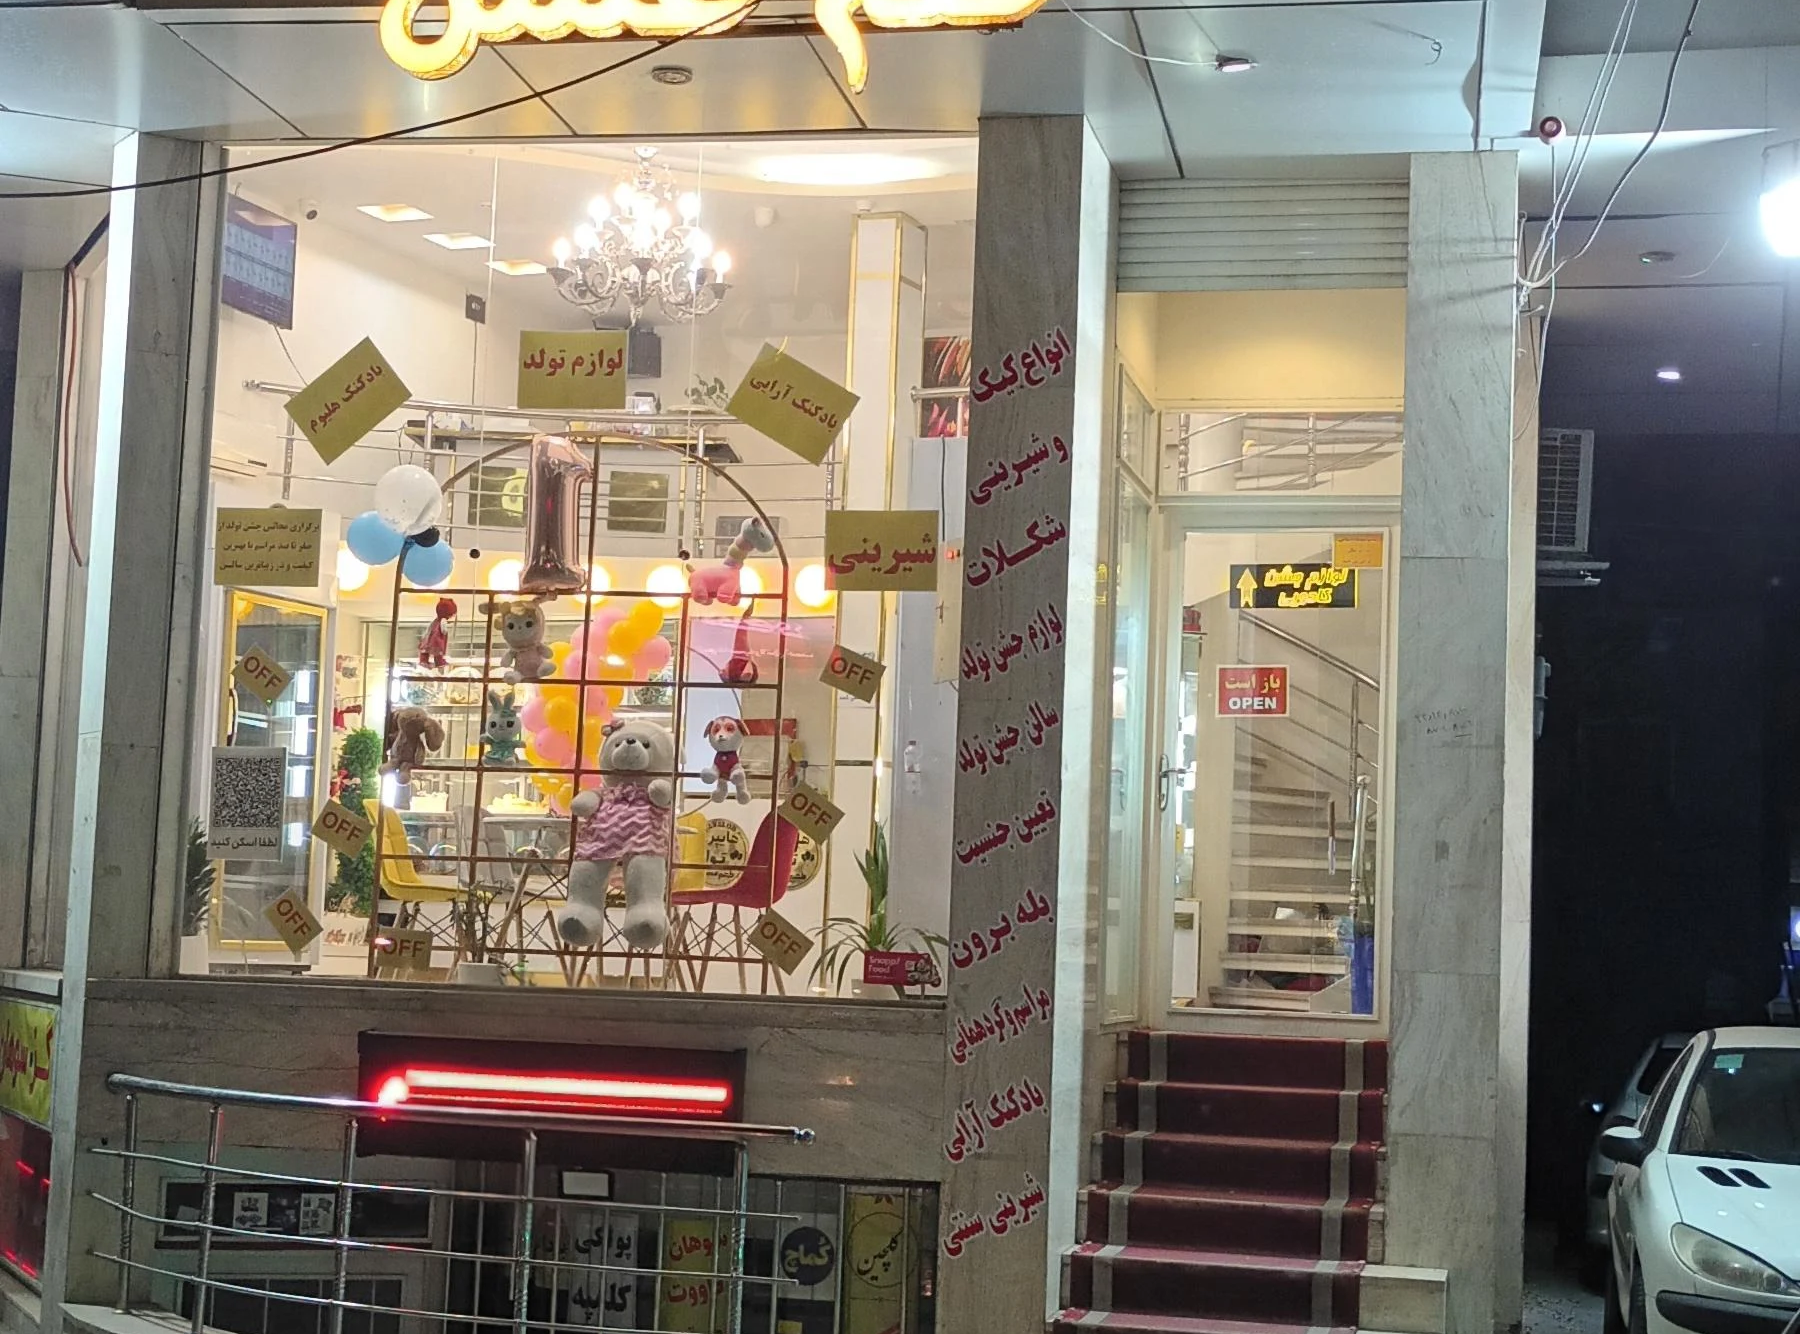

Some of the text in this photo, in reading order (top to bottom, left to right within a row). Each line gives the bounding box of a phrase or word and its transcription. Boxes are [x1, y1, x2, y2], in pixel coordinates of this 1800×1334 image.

[523, 347, 623, 376] لوازم تولد
[972, 327, 1071, 402] انواع کیک
[310, 365, 386, 434] بادکنک هلیوم
[749, 380, 838, 433] بادکنک آرایی
[970, 433, 1069, 505] و شیرینی
[828, 533, 937, 574] شیرینی
[966, 515, 1067, 587] شکلات
[1304, 567, 1349, 591] لوازم
[961, 603, 1063, 683] لوازم جشن تولد
[243, 656, 282, 688] OFF
[831, 657, 875, 685] OFF
[1224, 673, 1281, 694] باز است
[1228, 696, 1277, 710] OPEN
[958, 700, 1060, 776] سالن جشن تولد
[322, 811, 364, 842] OFF
[790, 793, 833, 827] OFF
[955, 790, 1056, 865] تعیین جنسیت
[211, 837, 278, 849] لطفا اسکن کنید
[277, 898, 311, 936] OFF
[951, 888, 1055, 968] بله برون
[382, 937, 425, 958] OFF
[760, 921, 803, 956] OFF
[1013, 984, 1050, 1032] مراسم
[945, 1078, 1048, 1162] بادکنک آرایی
[943, 1173, 1045, 1257] شیرینی سنتی
